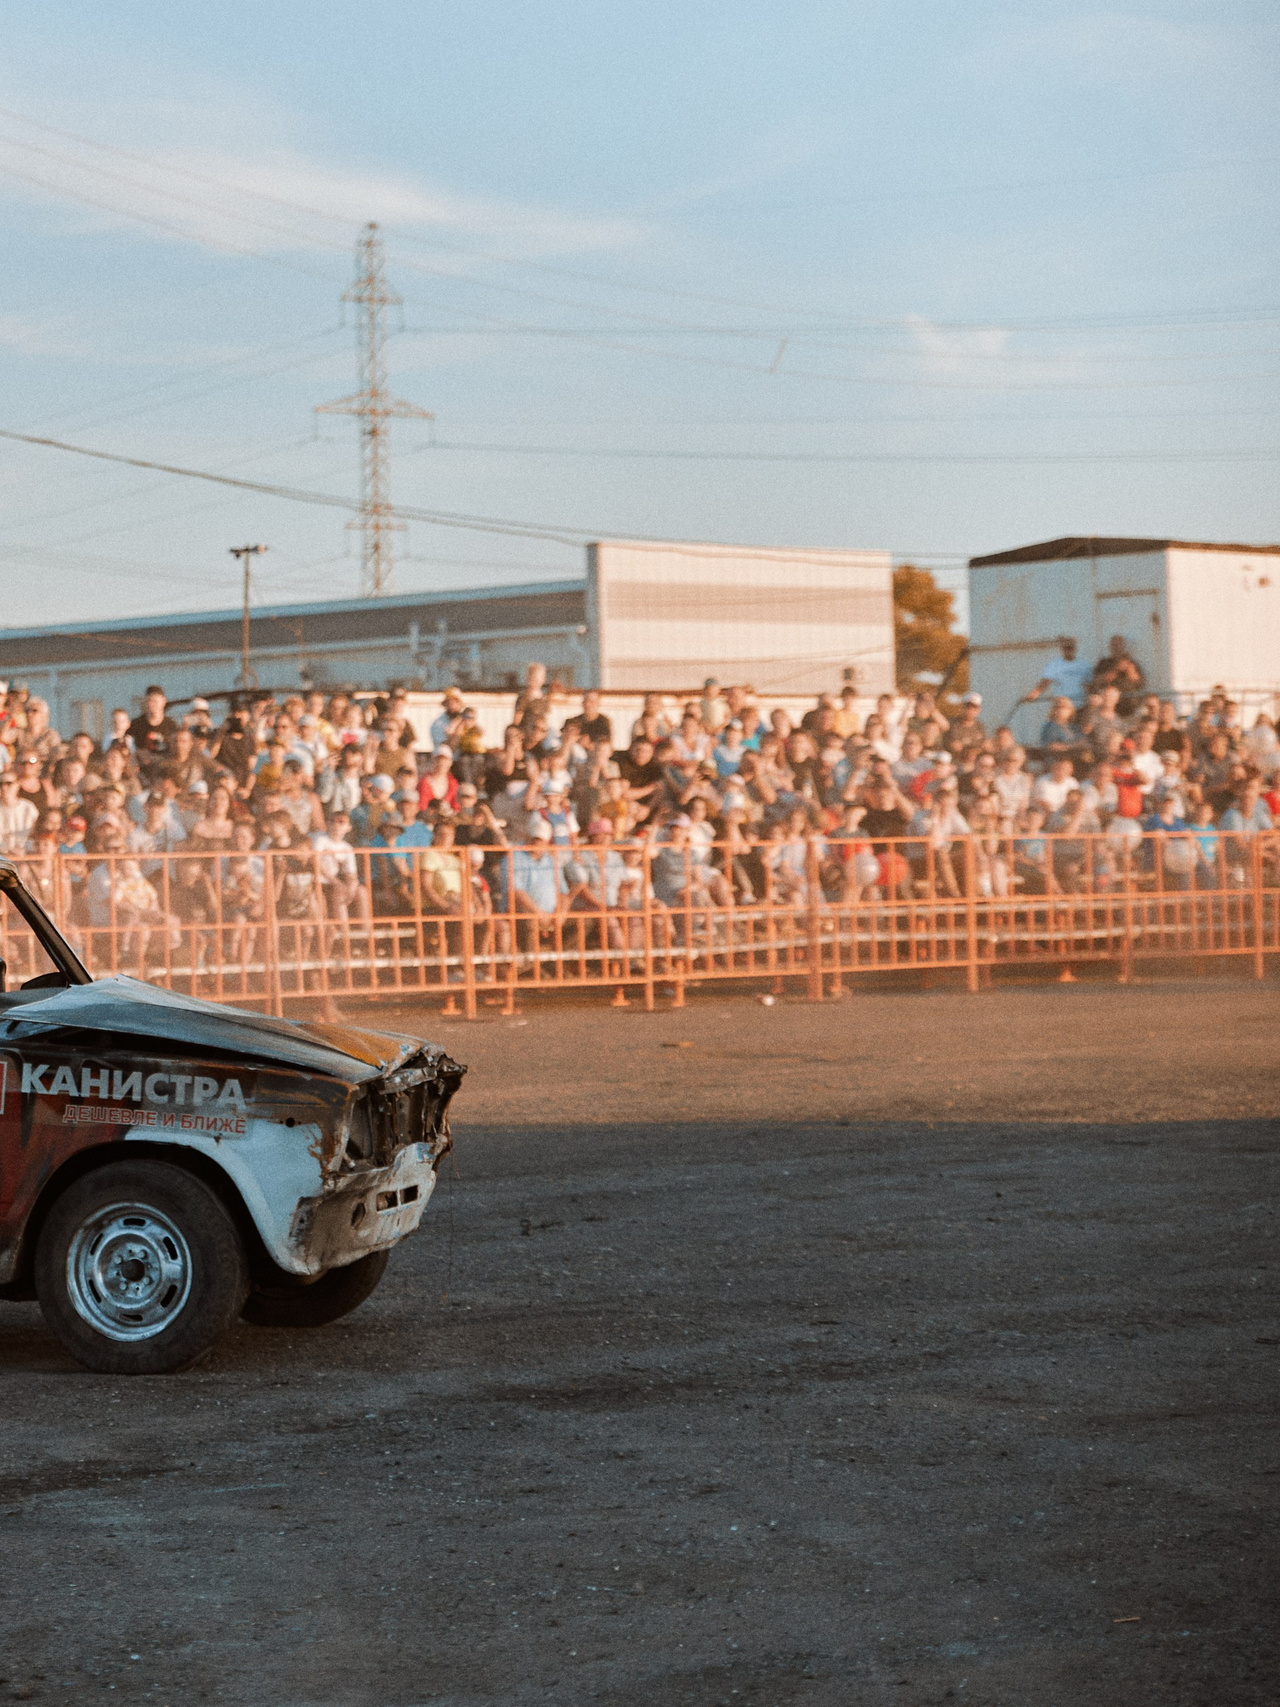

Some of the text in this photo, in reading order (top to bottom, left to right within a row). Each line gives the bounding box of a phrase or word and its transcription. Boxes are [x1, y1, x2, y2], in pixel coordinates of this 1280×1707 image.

[21, 1063, 248, 1109] КАНИСТРА
[62, 1104, 247, 1135] ДЕШЕВЛЕ И БЛИЖЕ
